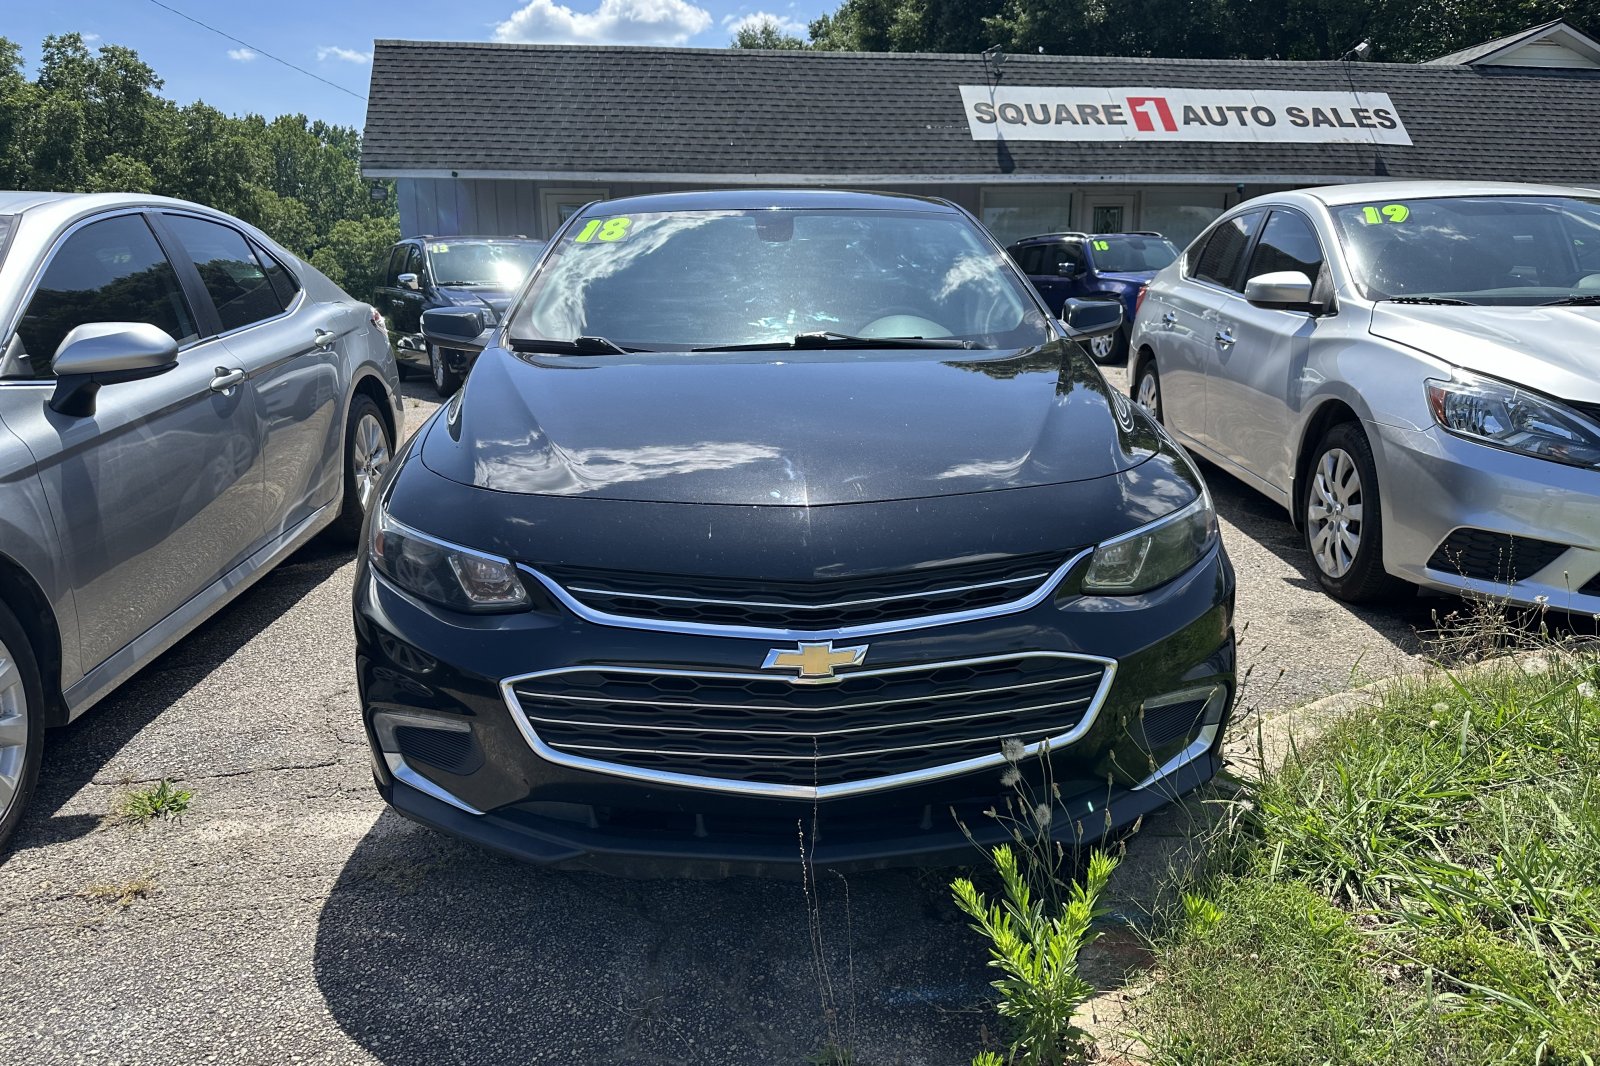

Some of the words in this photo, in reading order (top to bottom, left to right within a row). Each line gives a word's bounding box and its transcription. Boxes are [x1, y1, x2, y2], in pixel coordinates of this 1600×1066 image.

[974, 102, 1128, 126] SQUARE
[1131, 98, 1170, 132] 1
[1183, 105, 1276, 127] AUTO
[1285, 106, 1397, 130] SALES
[1362, 204, 1409, 224] 19
[575, 217, 632, 242] 18
